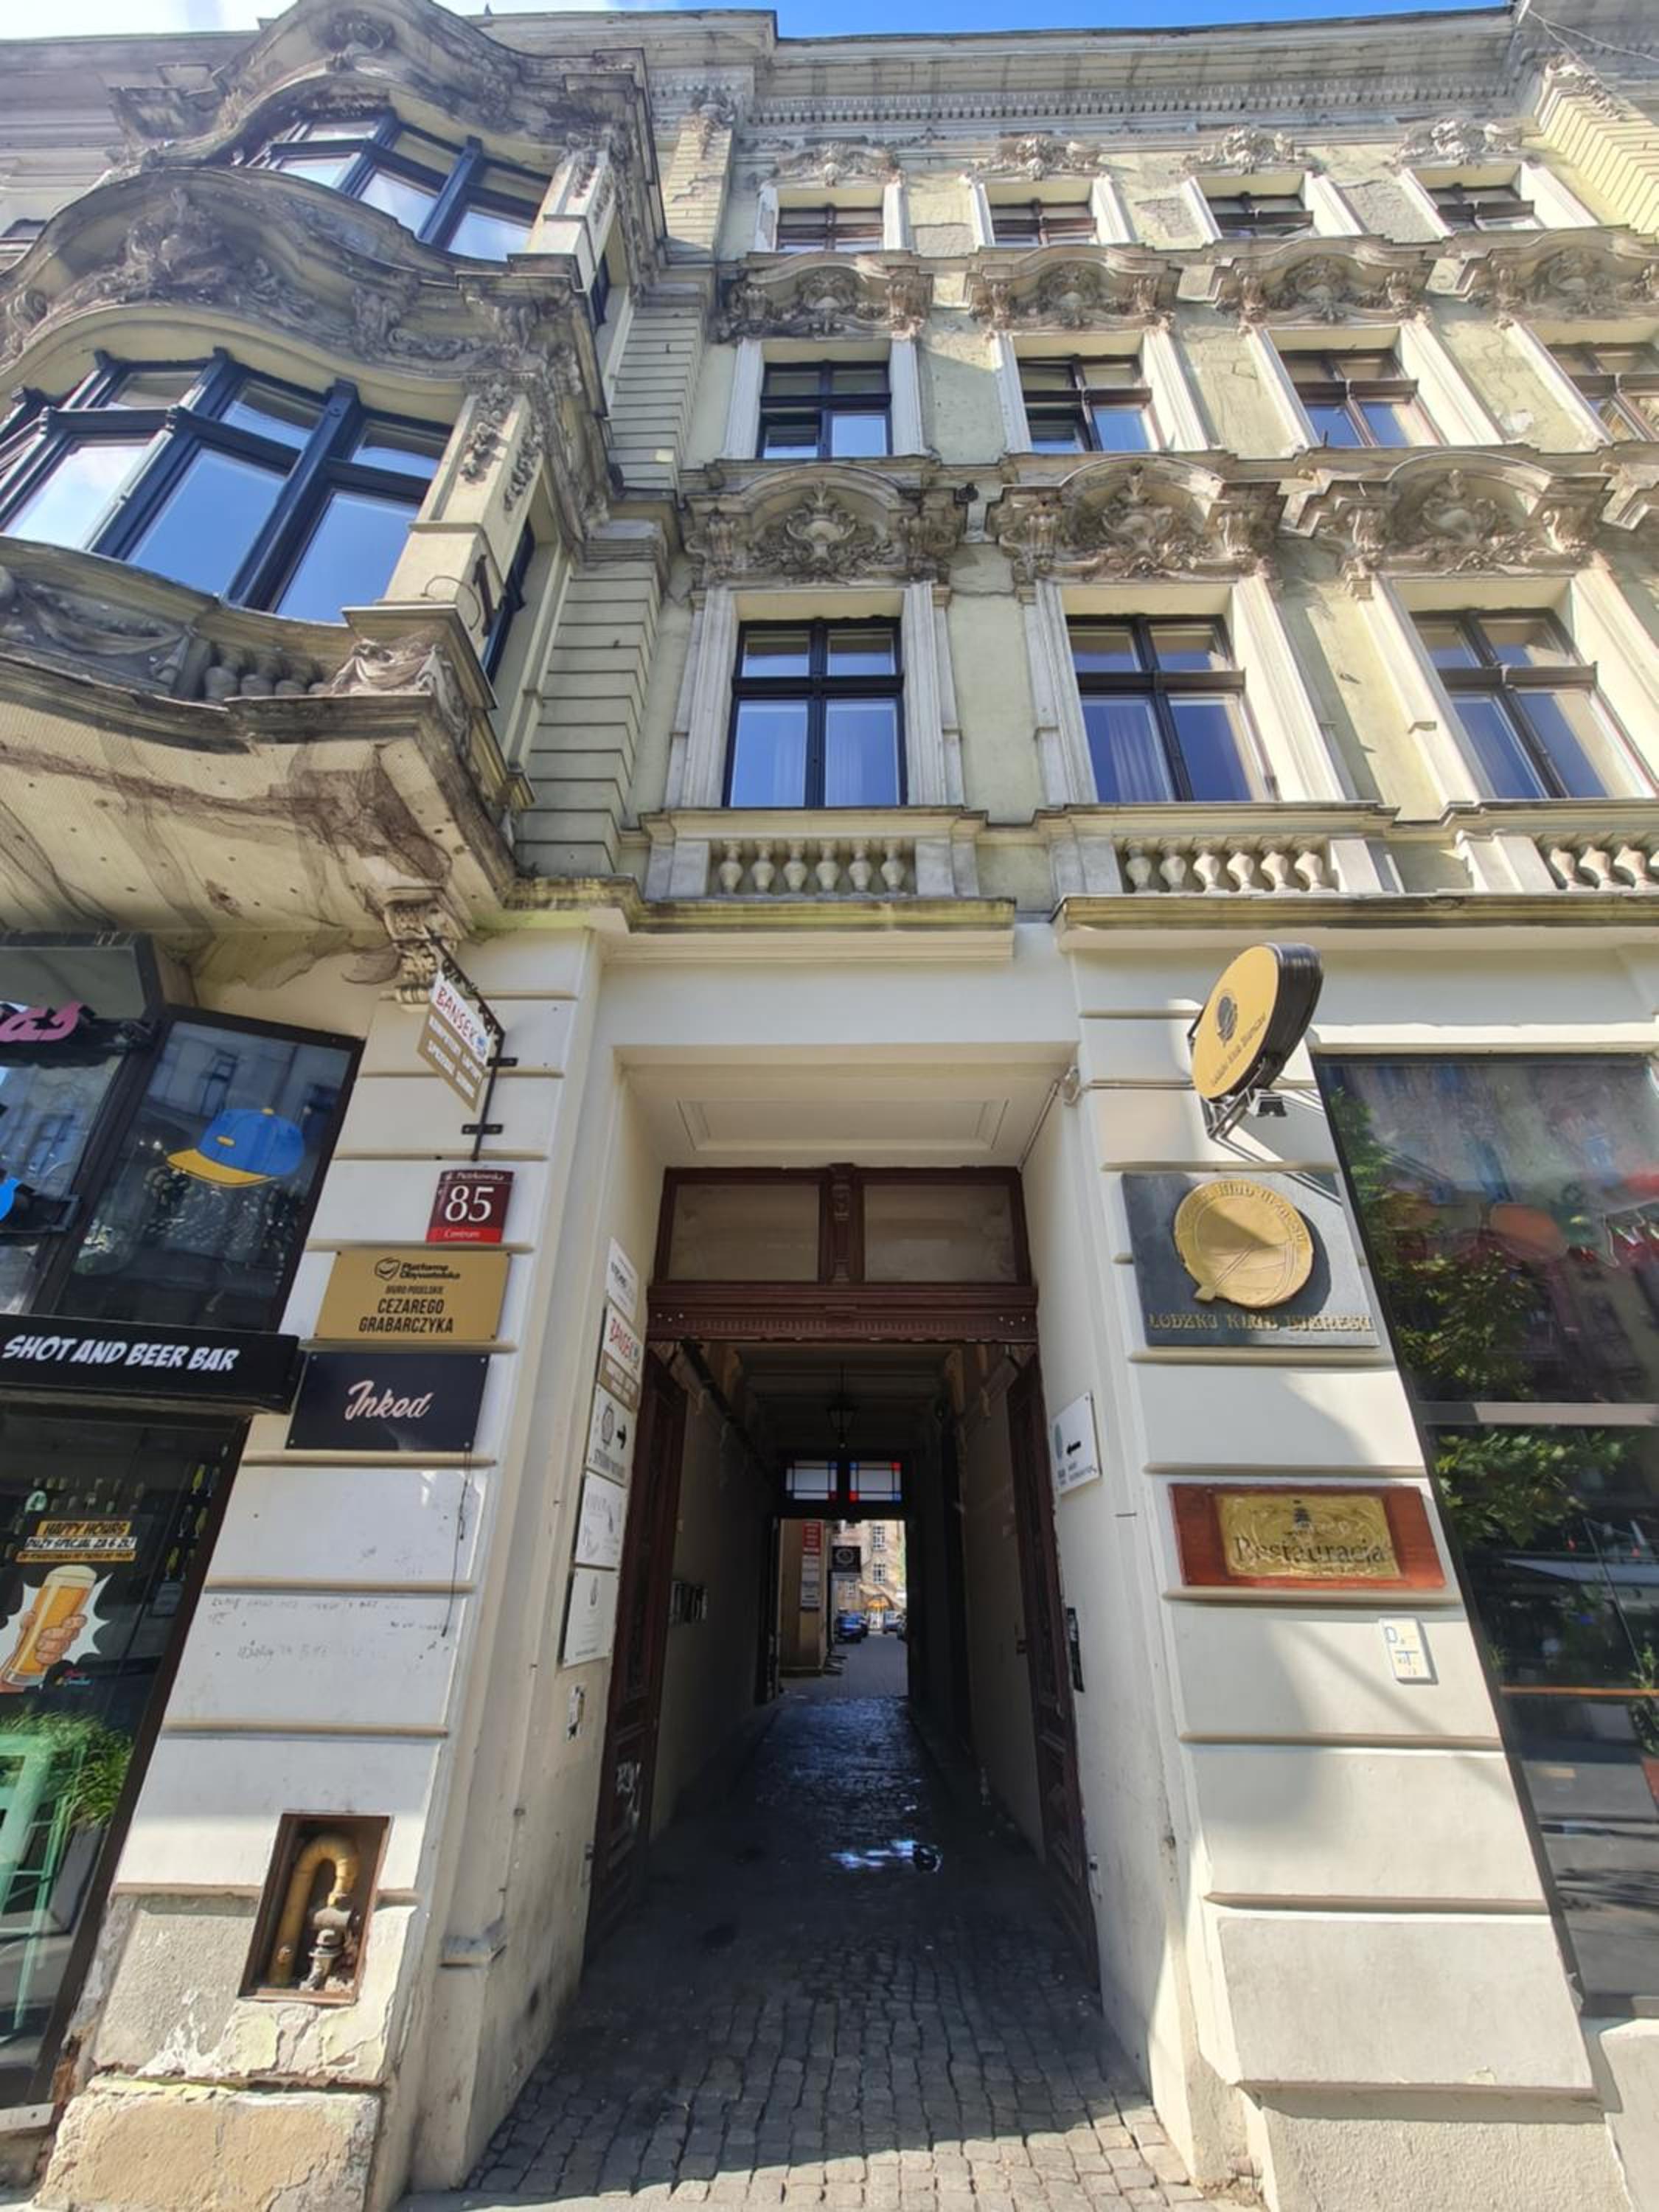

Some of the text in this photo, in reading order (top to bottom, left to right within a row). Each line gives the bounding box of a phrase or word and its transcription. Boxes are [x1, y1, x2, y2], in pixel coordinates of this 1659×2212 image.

[445, 1185, 494, 1222] 85
[444, 1228, 481, 1238] Centrum
[377, 1298, 445, 1315] CEZAREGO
[358, 1316, 453, 1334] GRABARCZYKA
[1, 1335, 240, 1371] SHOT AND BEER BAR
[344, 1380, 434, 1421] Inked
[1234, 1535, 1385, 1564] Restauracja
